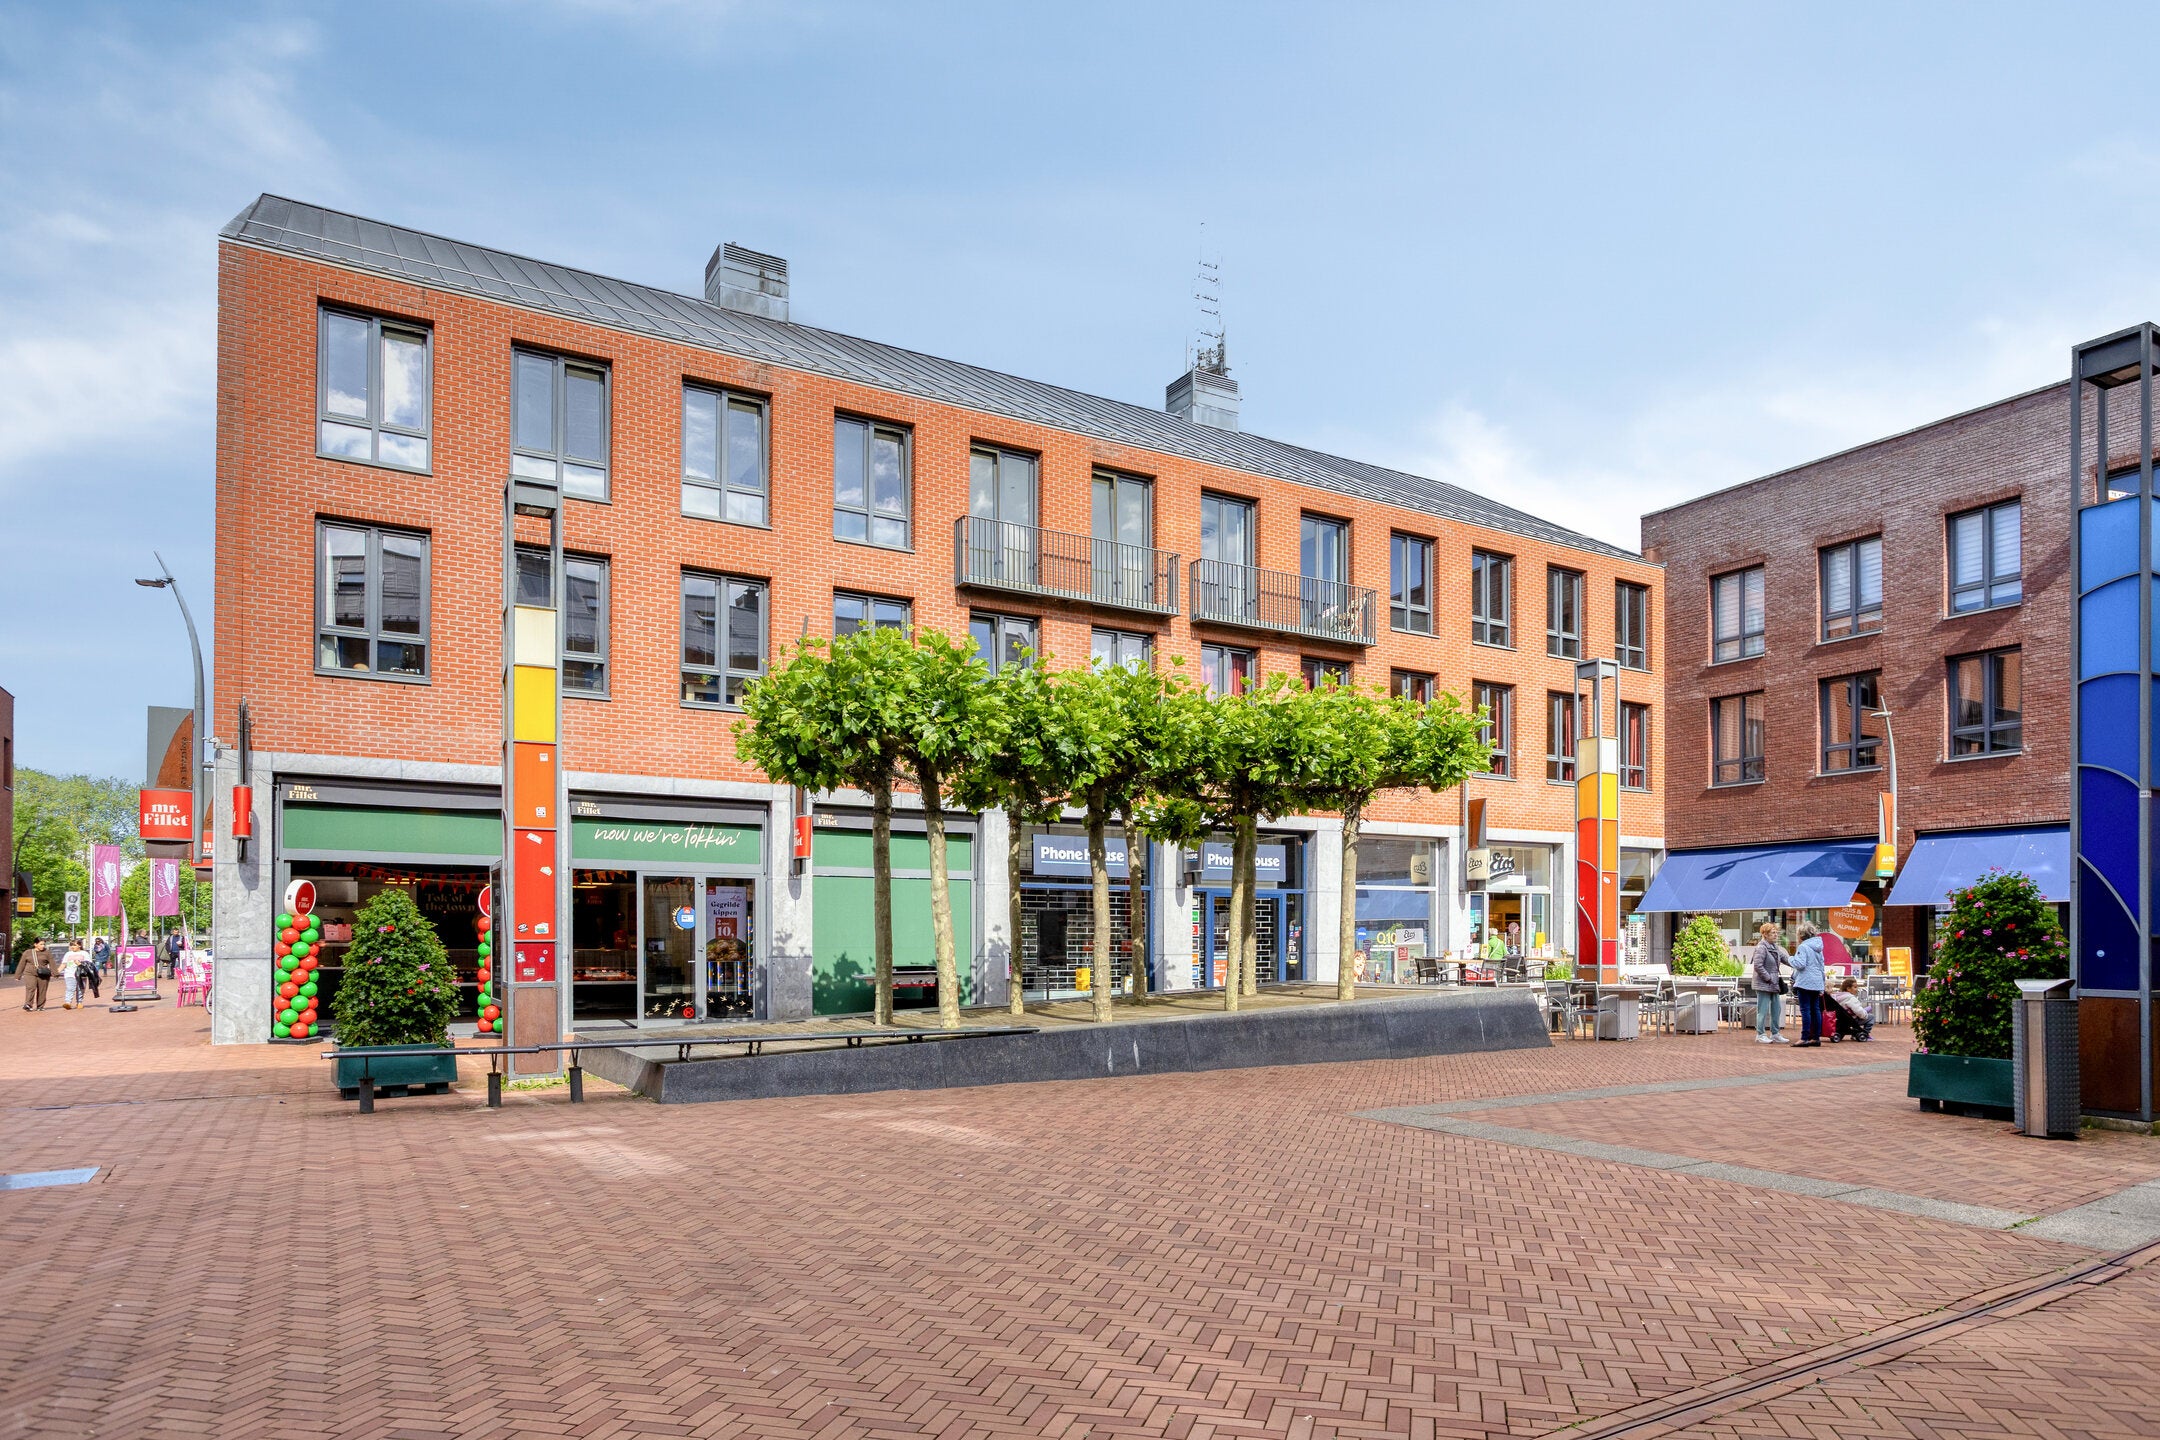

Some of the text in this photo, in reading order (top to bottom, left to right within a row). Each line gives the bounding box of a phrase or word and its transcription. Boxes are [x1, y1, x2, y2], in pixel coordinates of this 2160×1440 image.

[288, 790, 318, 800] Fillet
[151, 803, 181, 814] mr.
[577, 807, 601, 815] Fillet
[143, 813, 189, 827] Fillet
[818, 818, 838, 826] Fillet
[594, 827, 629, 841] now
[633, 828, 684, 845] we're
[1040, 846, 1125, 862] Phone Huse
[1207, 853, 1280, 867] Pho ouse
[1468, 857, 1483, 873] Etos
[1489, 852, 1516, 881] Etos
[1833, 911, 1869, 920] HYPOTHEEK
[1376, 932, 1396, 944] Q10
